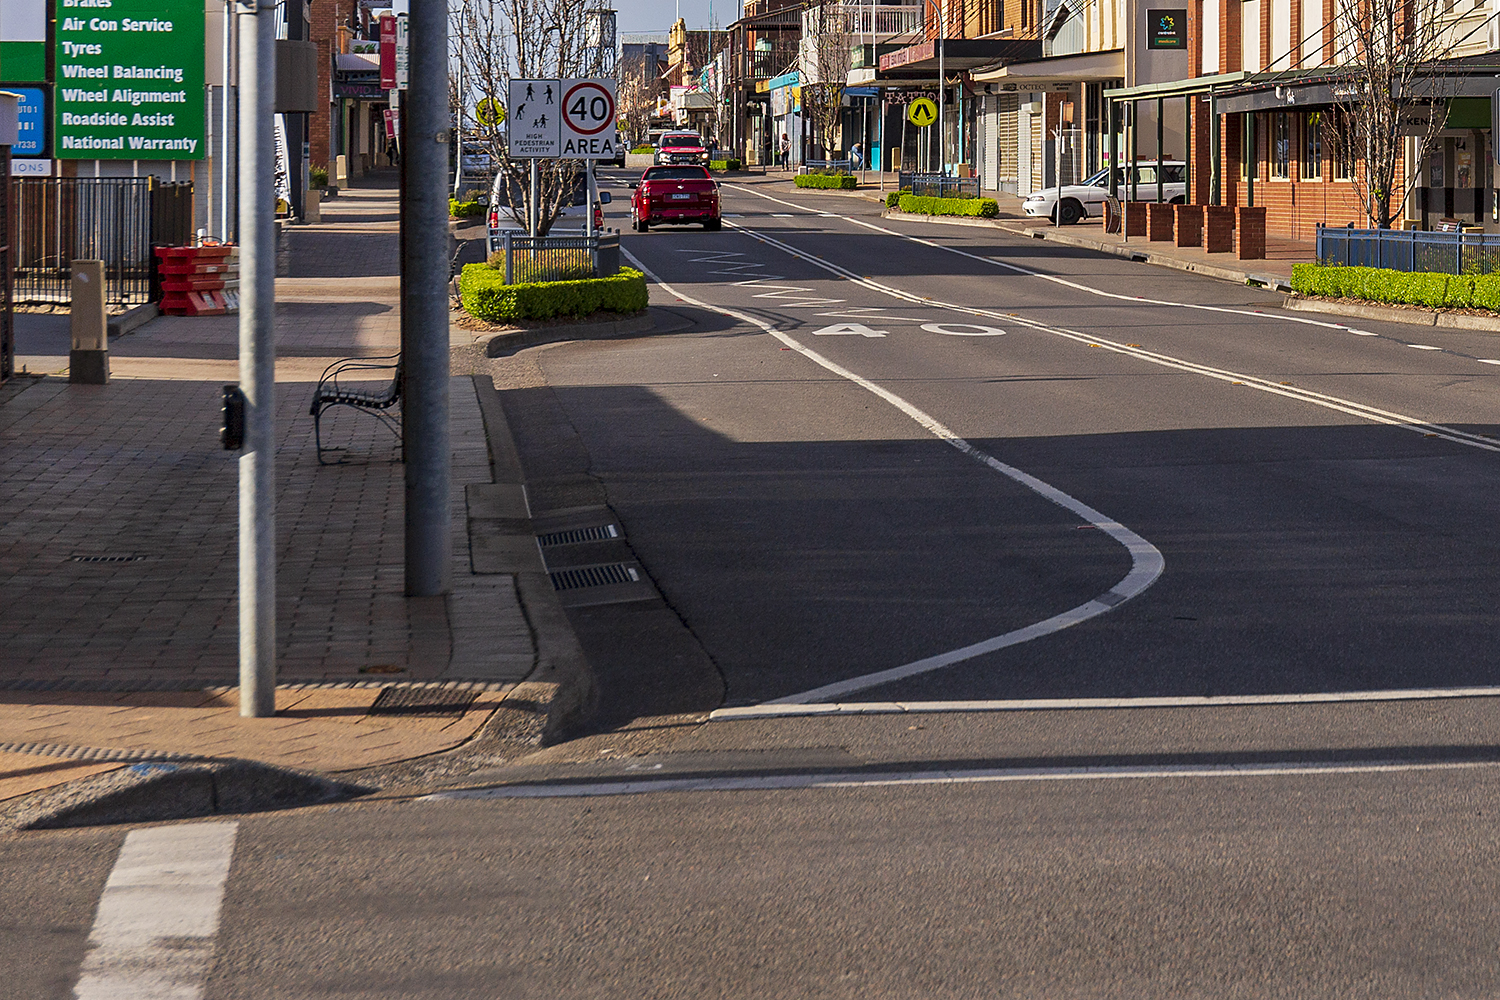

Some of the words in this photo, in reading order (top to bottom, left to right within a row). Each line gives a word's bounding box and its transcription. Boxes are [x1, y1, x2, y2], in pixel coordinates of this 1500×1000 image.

[62, 17, 86, 31] Air
[90, 18, 118, 32] Con
[122, 18, 173, 32] Service
[62, 41, 102, 58] Tyres
[62, 65, 108, 79] Wheel
[113, 66, 184, 82] Balancing
[62, 89, 108, 102] Wheel
[112, 89, 186, 106] Alignment
[569, 96, 607, 122] 40
[62, 112, 128, 126] Roadside
[131, 113, 174, 126] Assist
[62, 136, 124, 149] National
[128, 136, 198, 153] Warranty
[564, 138, 614, 154] AREA
[813, 323, 1006, 338] 40
